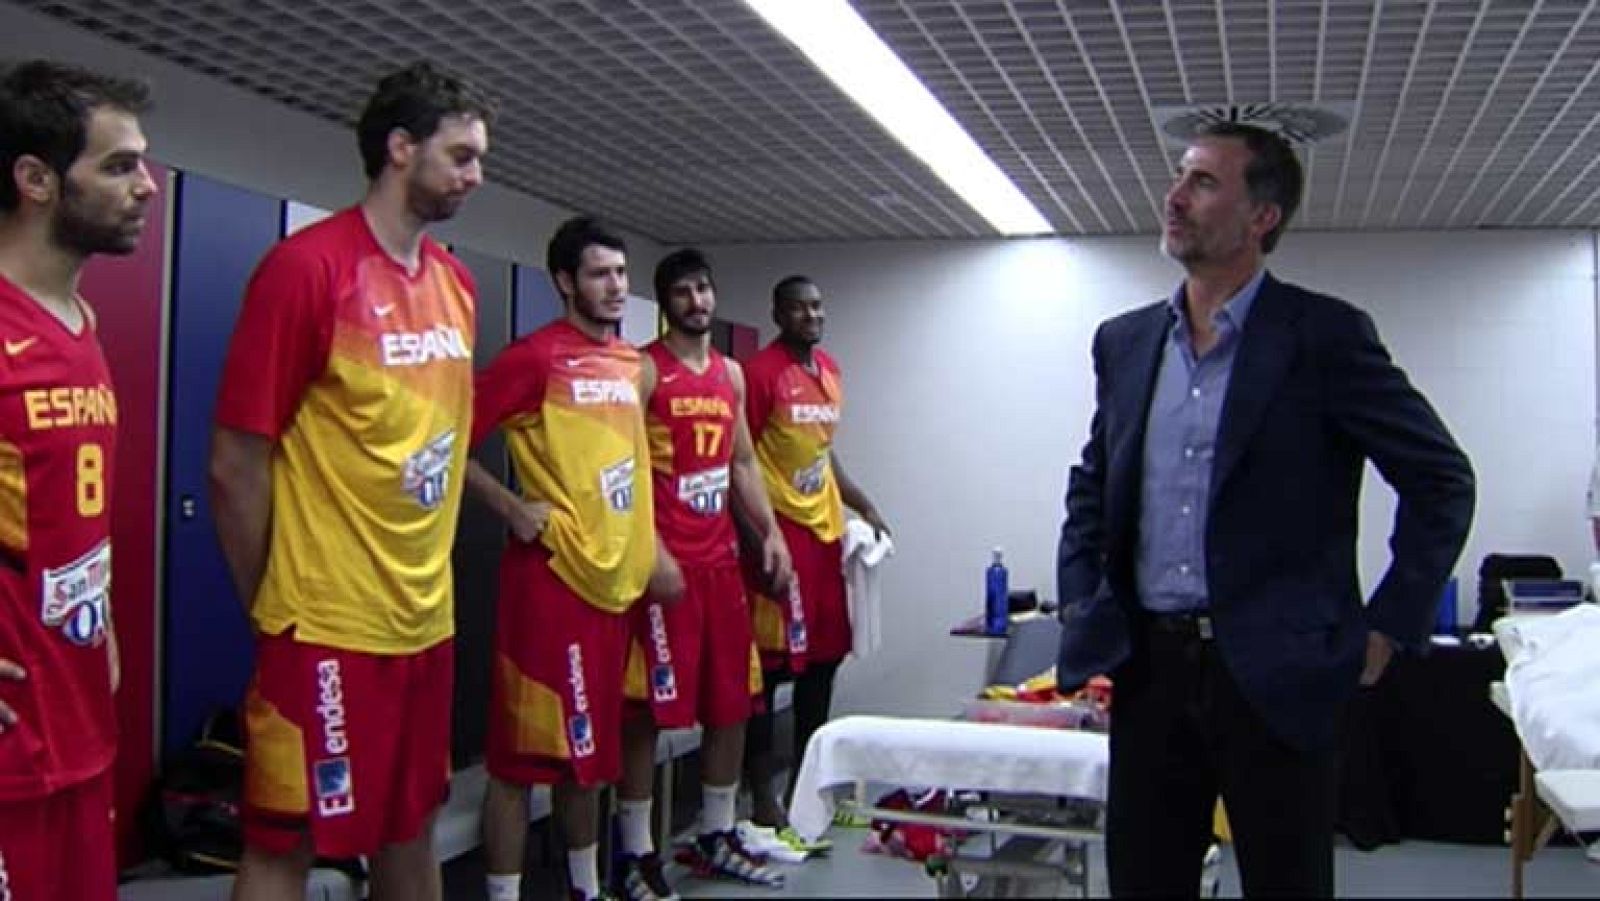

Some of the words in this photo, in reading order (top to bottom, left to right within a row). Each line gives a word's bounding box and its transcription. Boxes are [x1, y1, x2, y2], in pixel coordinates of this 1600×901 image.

[694, 422, 723, 457] 17
[77, 443, 104, 516] 8
[316, 659, 349, 753] endesa
